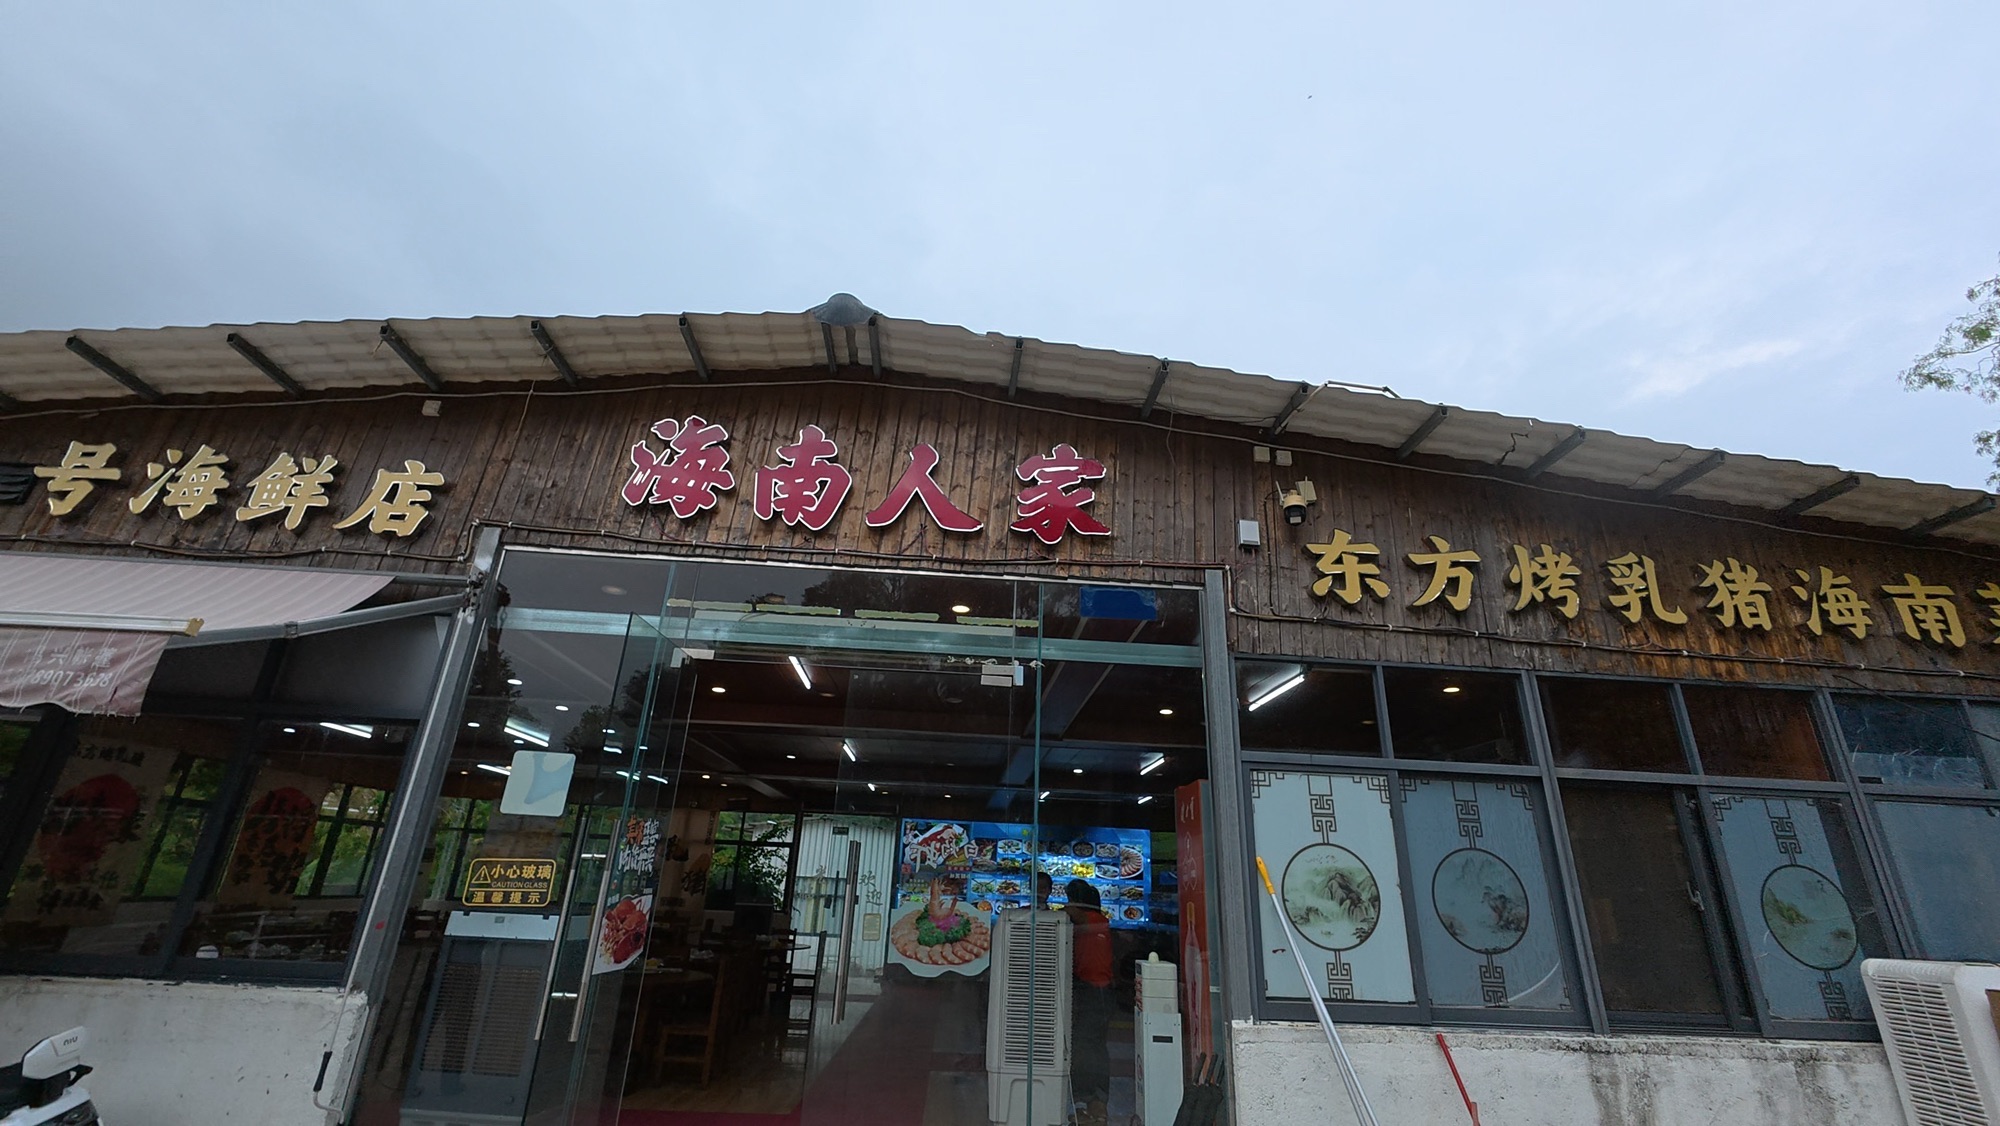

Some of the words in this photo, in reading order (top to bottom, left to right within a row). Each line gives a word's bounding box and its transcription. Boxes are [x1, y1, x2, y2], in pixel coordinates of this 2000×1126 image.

[33, 440, 446, 538] 号海鲜店
[621, 415, 1112, 546] 海南人家
[490, 863, 553, 880] 小心玻璃
[491, 881, 523, 889] CAUTION
[524, 881, 548, 889] GLASS
[471, 891, 541, 904] 温馨提示
